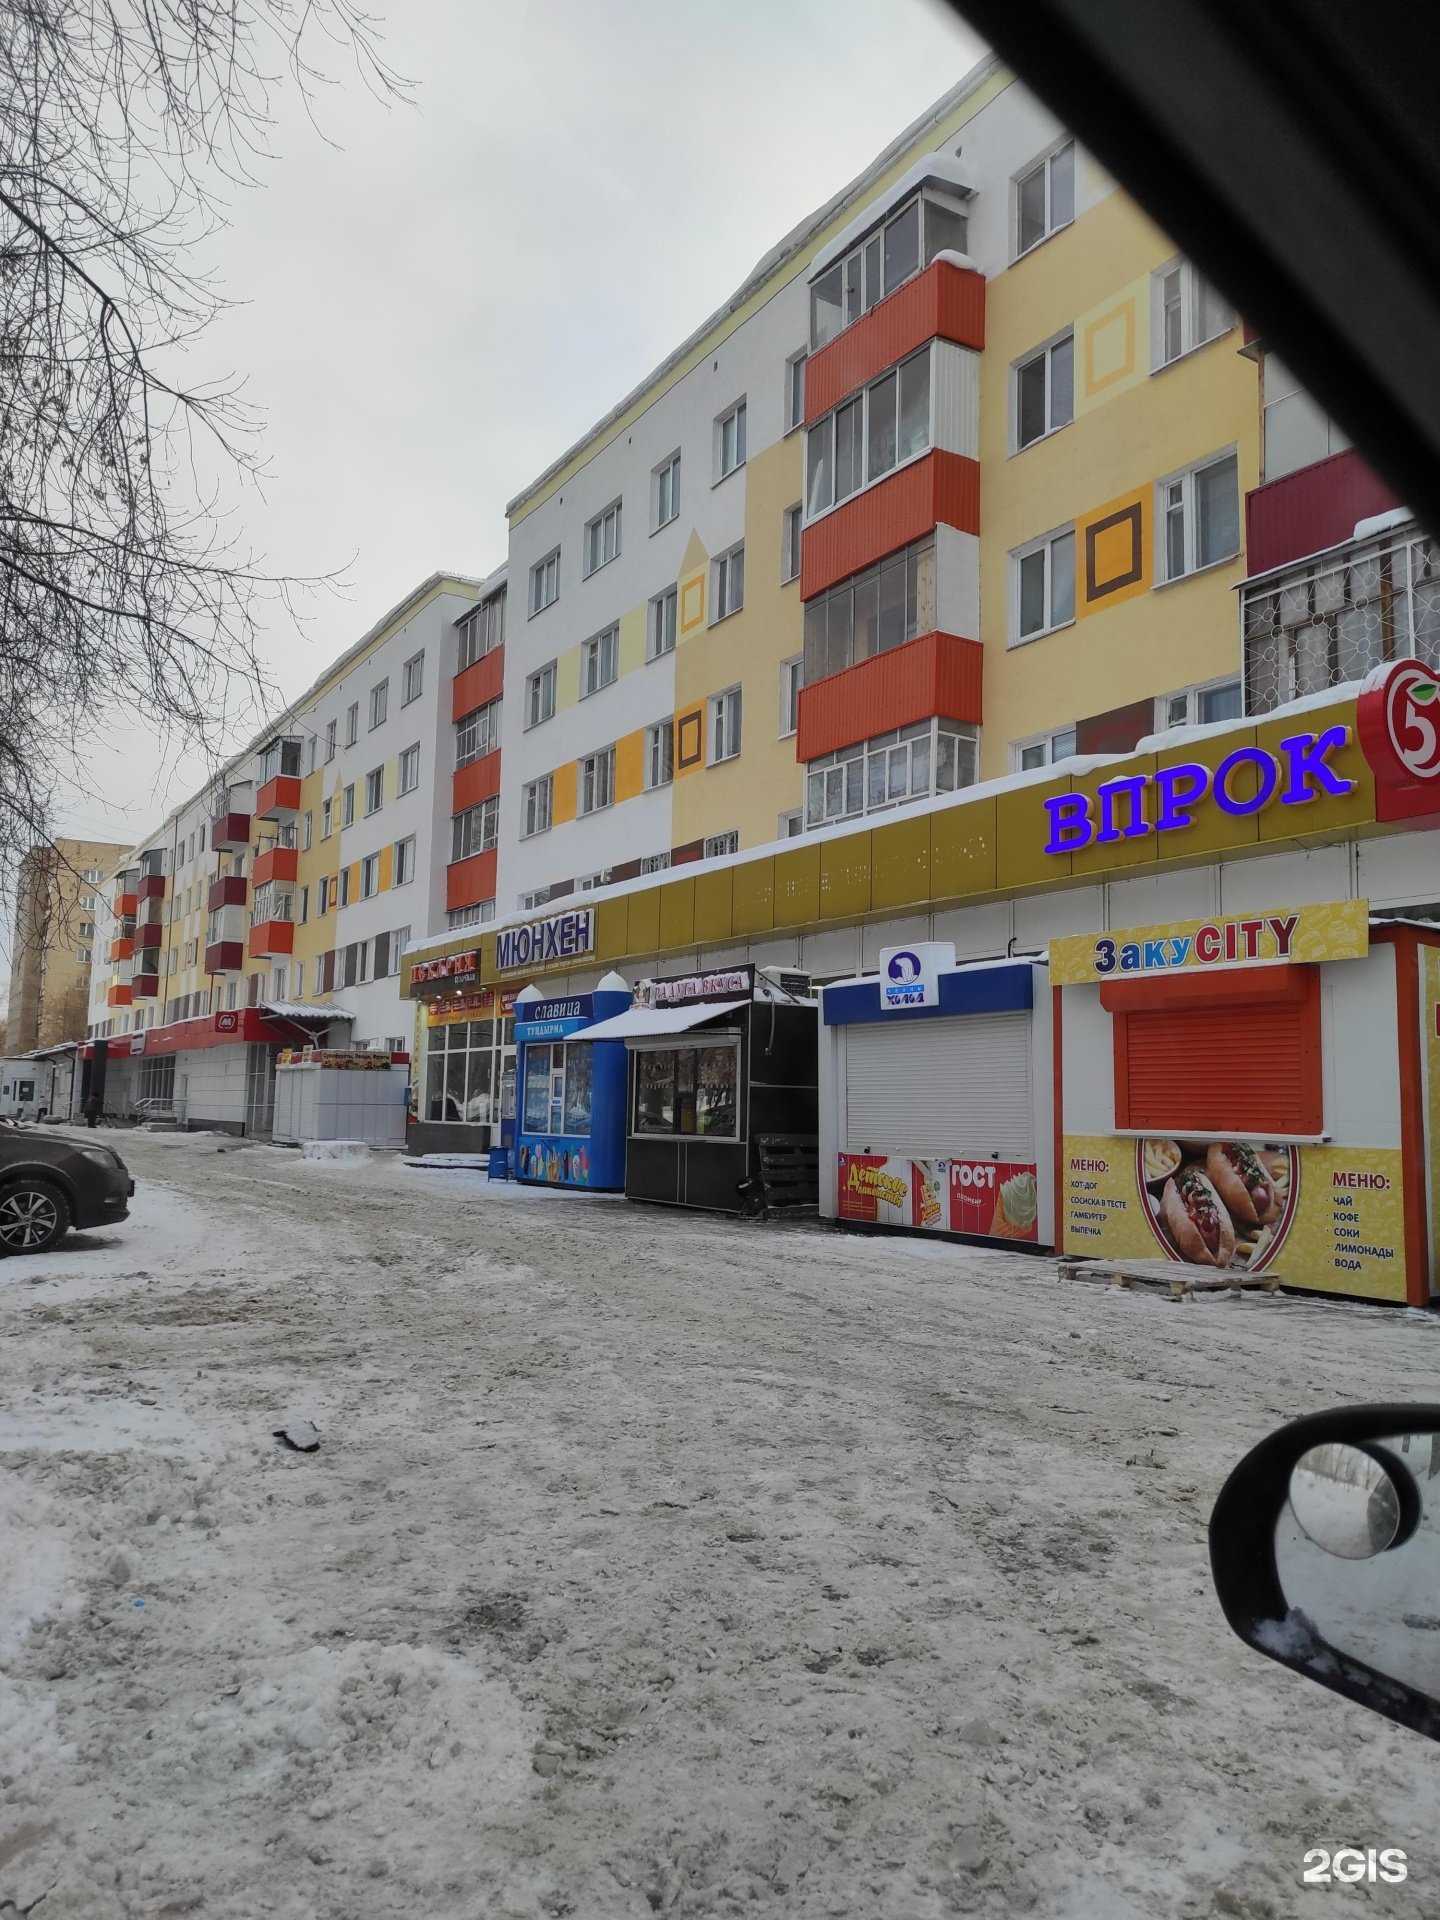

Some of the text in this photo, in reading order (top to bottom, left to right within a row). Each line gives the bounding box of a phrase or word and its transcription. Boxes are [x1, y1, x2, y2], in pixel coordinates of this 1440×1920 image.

[1043, 725, 1358, 854] ВПРОК
[496, 911, 590, 969] МЮНХЕН
[1070, 1159, 1109, 1173] МЕНЮ:
[951, 1165, 996, 1189] ГОСТ
[1333, 1171, 1391, 1190] МЕНЮ:
[1107, 1199, 1127, 1209] ТЕСТЕ
[1333, 1196, 1353, 1207] ЧАЙ
[1333, 1212, 1360, 1223] КОФЕ
[1070, 1225, 1102, 1236] ВЫПЕЧКА
[1334, 1227, 1360, 1239] СОКИ
[1334, 1243, 1394, 1259] ЛИМОНАДЫ
[1334, 1258, 1362, 1271] ВОДА
